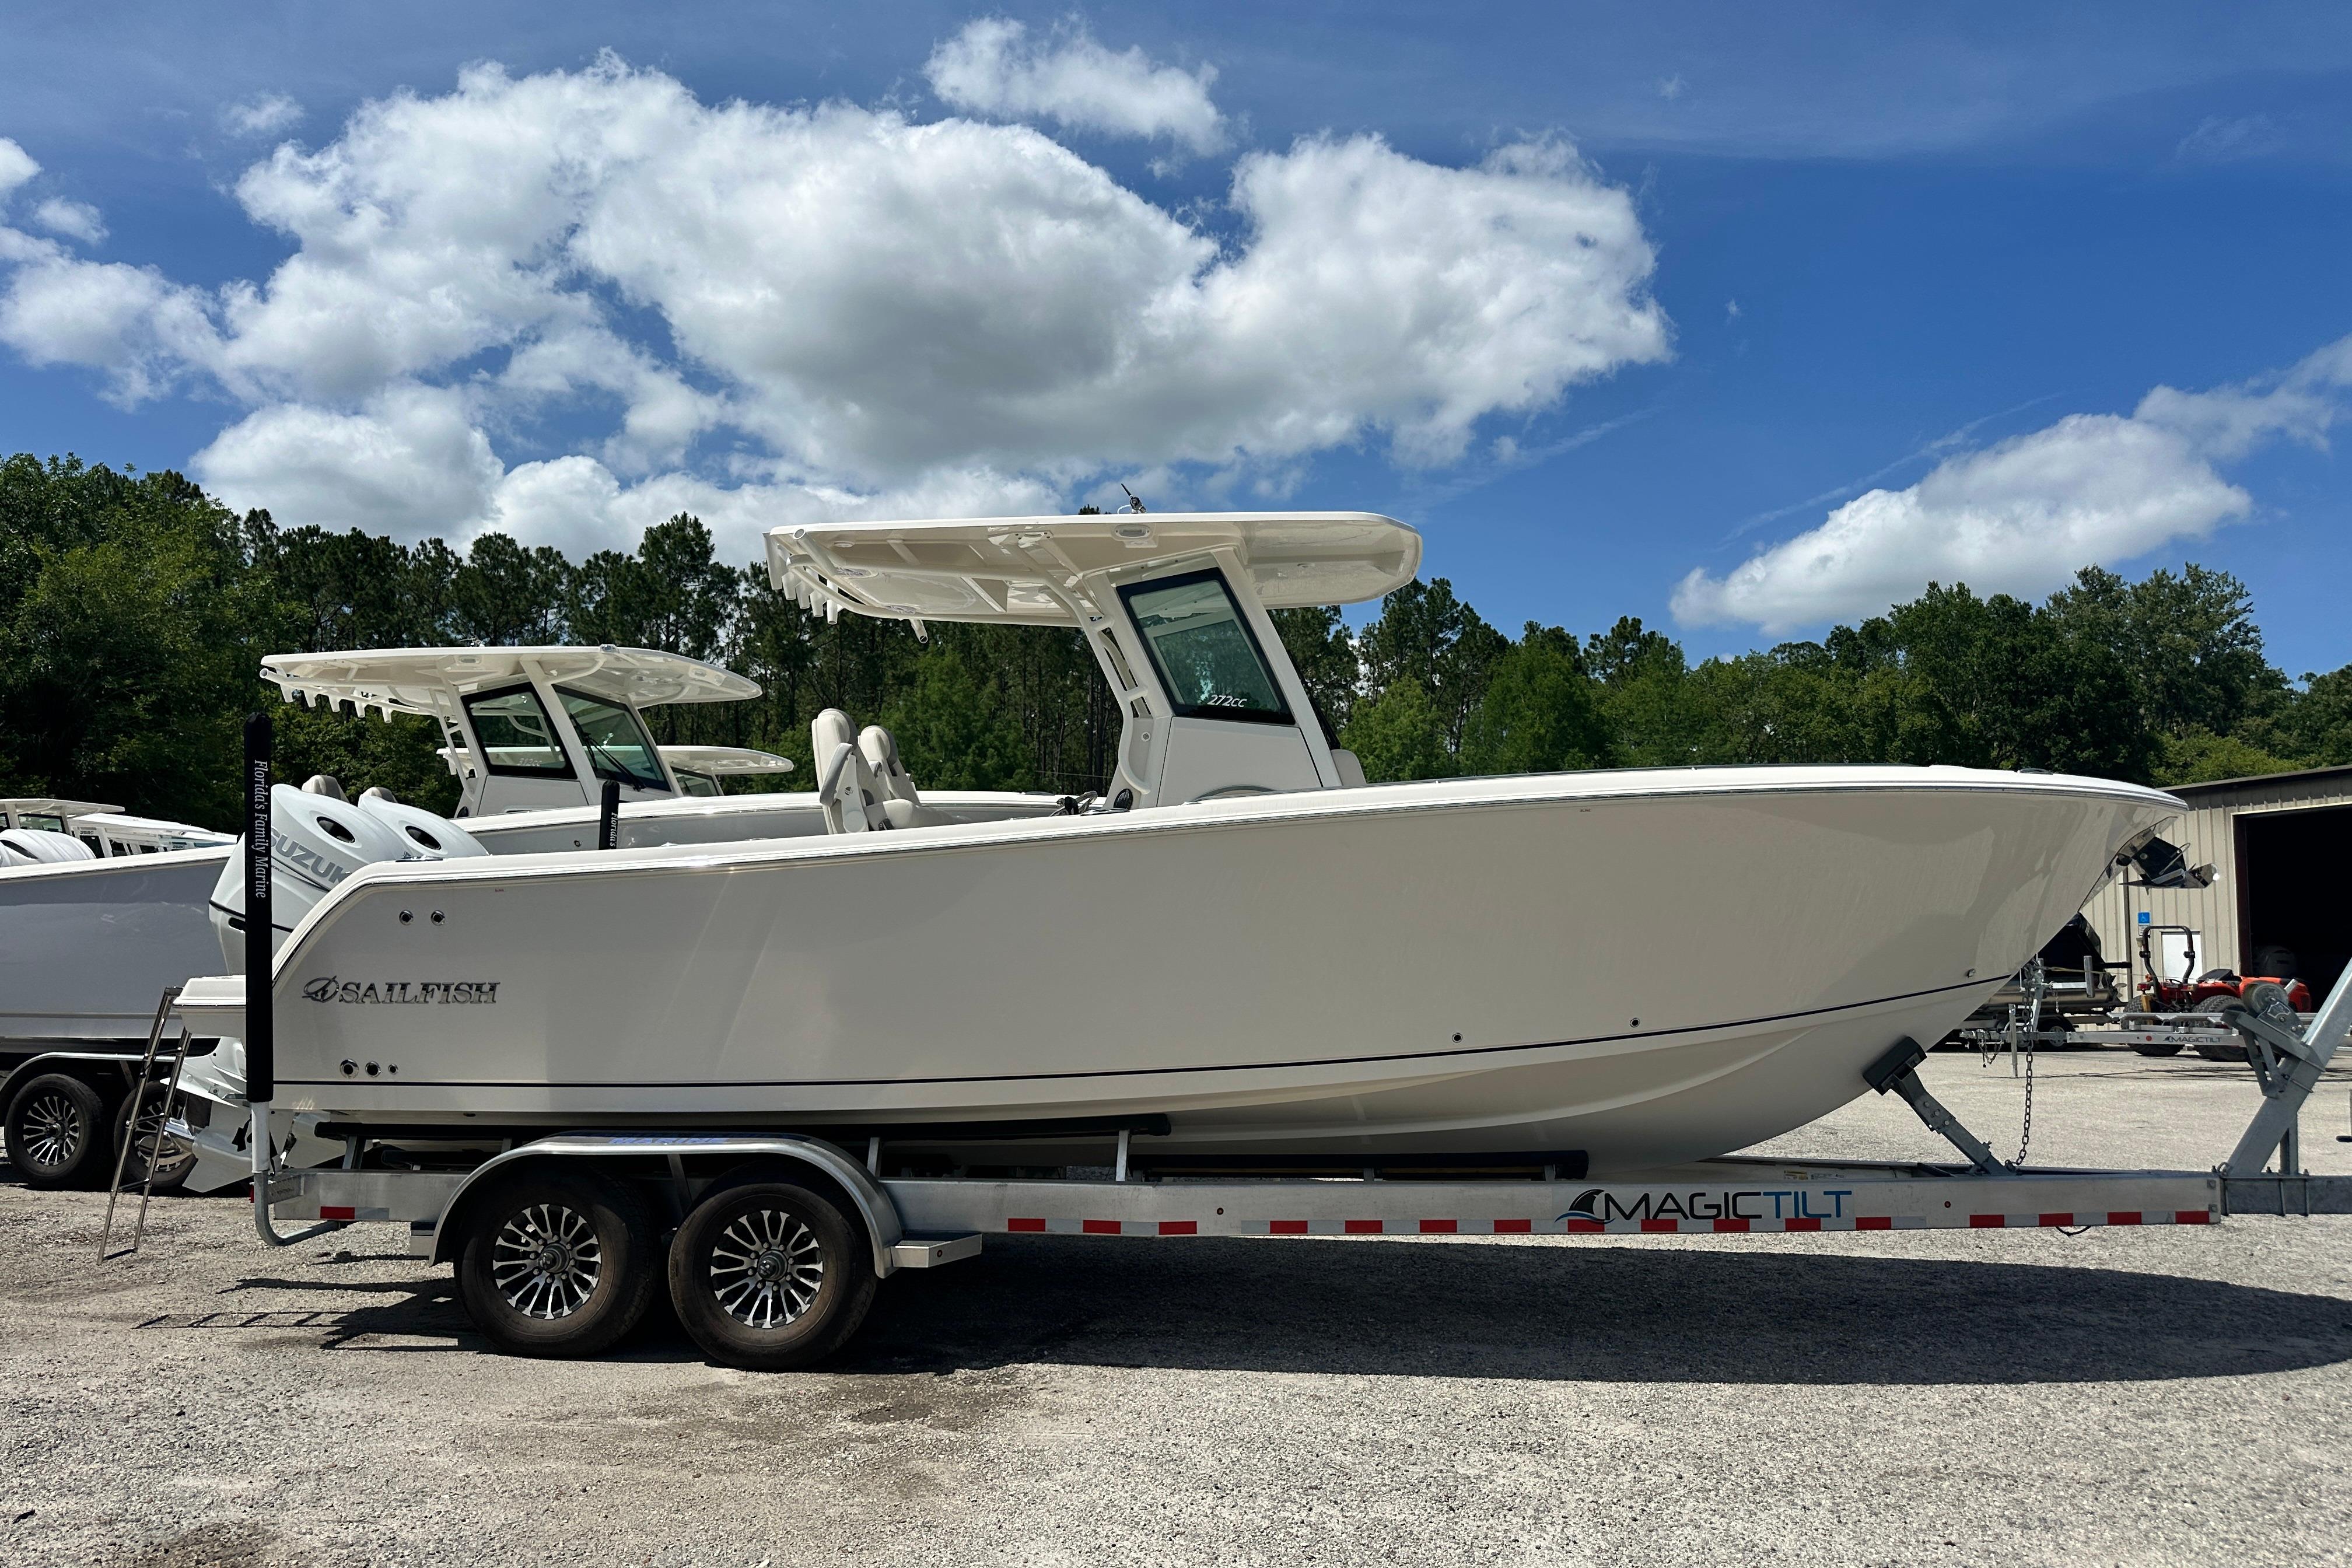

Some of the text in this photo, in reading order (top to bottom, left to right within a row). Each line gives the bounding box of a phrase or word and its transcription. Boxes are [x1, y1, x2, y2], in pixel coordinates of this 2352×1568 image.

[251, 760, 269, 898] Florida's Family Marine
[271, 826, 352, 884] SUZUK
[338, 981, 501, 1004] SAILFISH
[1604, 1191, 1852, 1221] MAGICTILT
